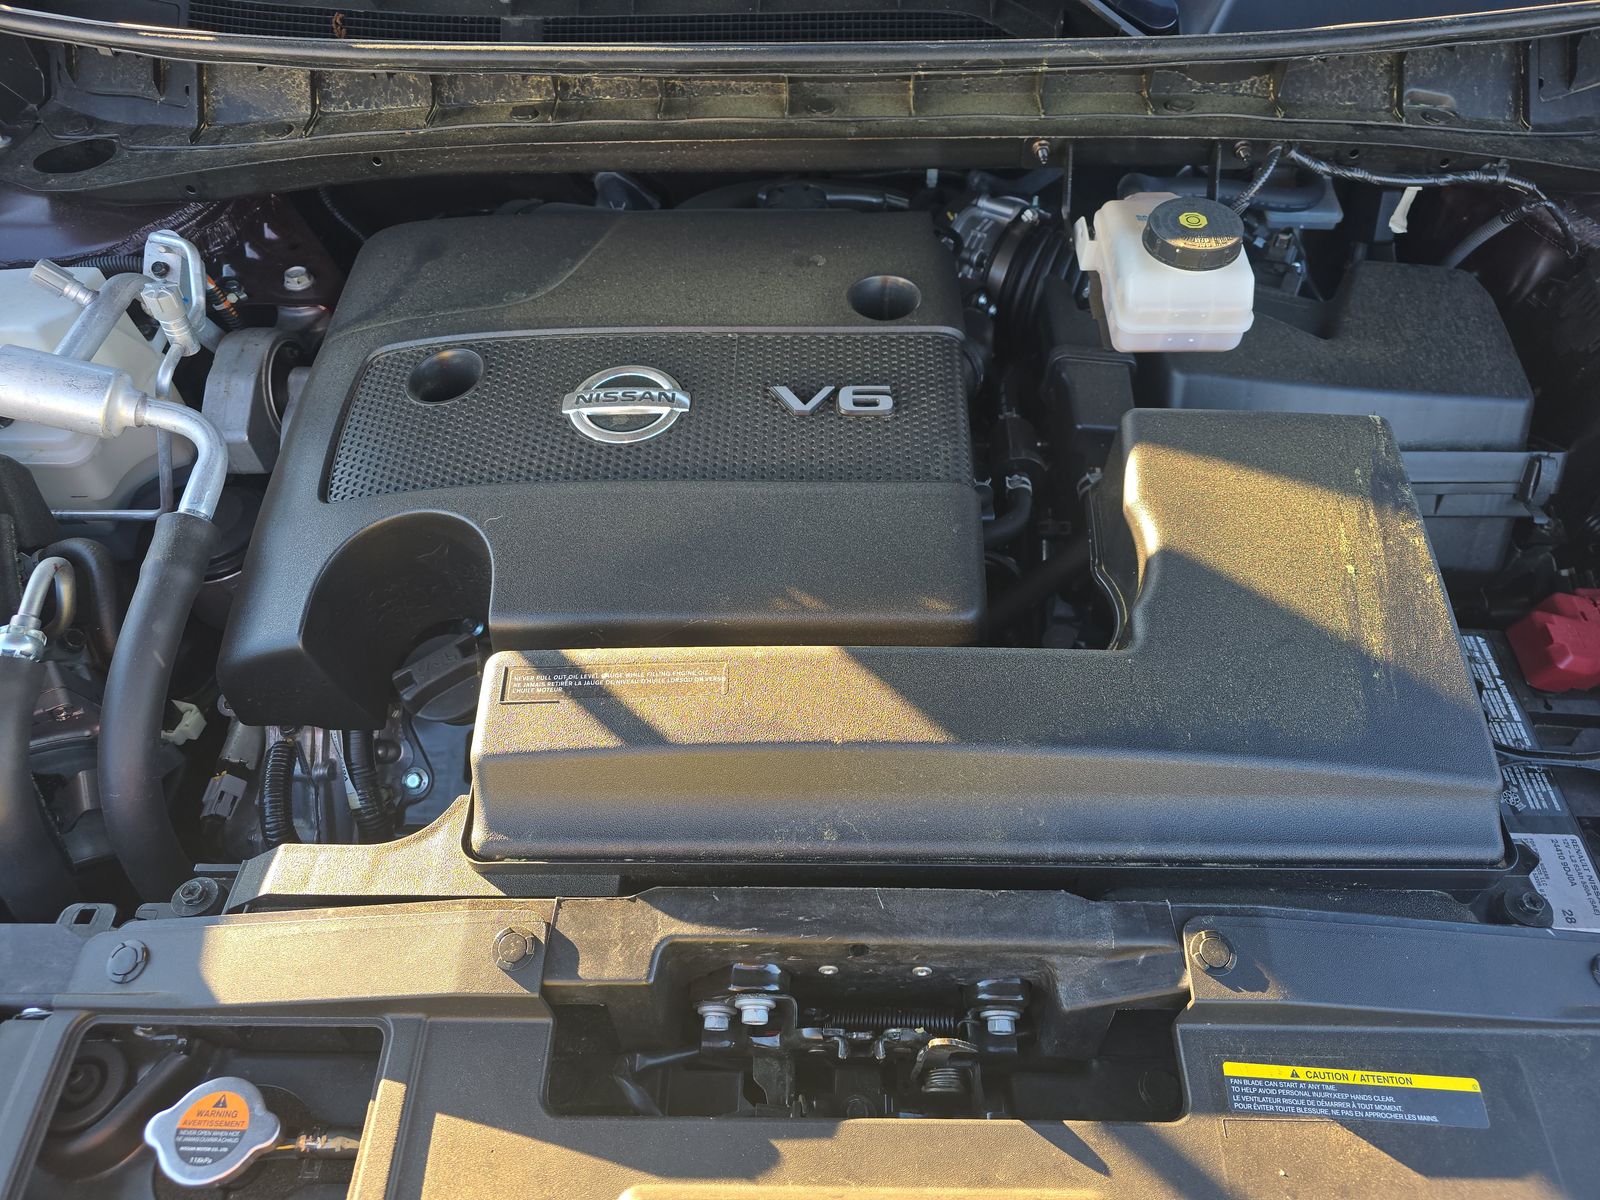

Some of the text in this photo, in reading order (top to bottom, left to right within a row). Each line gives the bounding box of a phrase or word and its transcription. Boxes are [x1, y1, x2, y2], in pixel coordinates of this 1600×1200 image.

[575, 391, 676, 405] NISSAN
[768, 385, 894, 417] V6
[1570, 838, 1591, 873] RENAULT
[1561, 909, 1577, 925] 28
[1243, 1079, 1264, 1087] BLADE
[1305, 1070, 1350, 1082] CAUTION
[1360, 1073, 1413, 1086] ATTENTION
[1278, 1089, 1311, 1097] PERSONAL
[1240, 1095, 1281, 1105] VENTILATEUR
[1282, 1098, 1305, 1106] RISQUE
[1316, 1099, 1351, 1109] DÉMARRER
[1351, 1101, 1357, 1109] À
[1375, 1104, 1404, 1112] MOMENT.
[1253, 1103, 1274, 1111] ÉVITER
[1296, 1107, 1331, 1116] BLESSURE,
[1364, 1111, 1404, 1120] APPROCHER
[196, 1110, 238, 1118] WARNING
[182, 1119, 245, 1128] AVERTISSEMENT
